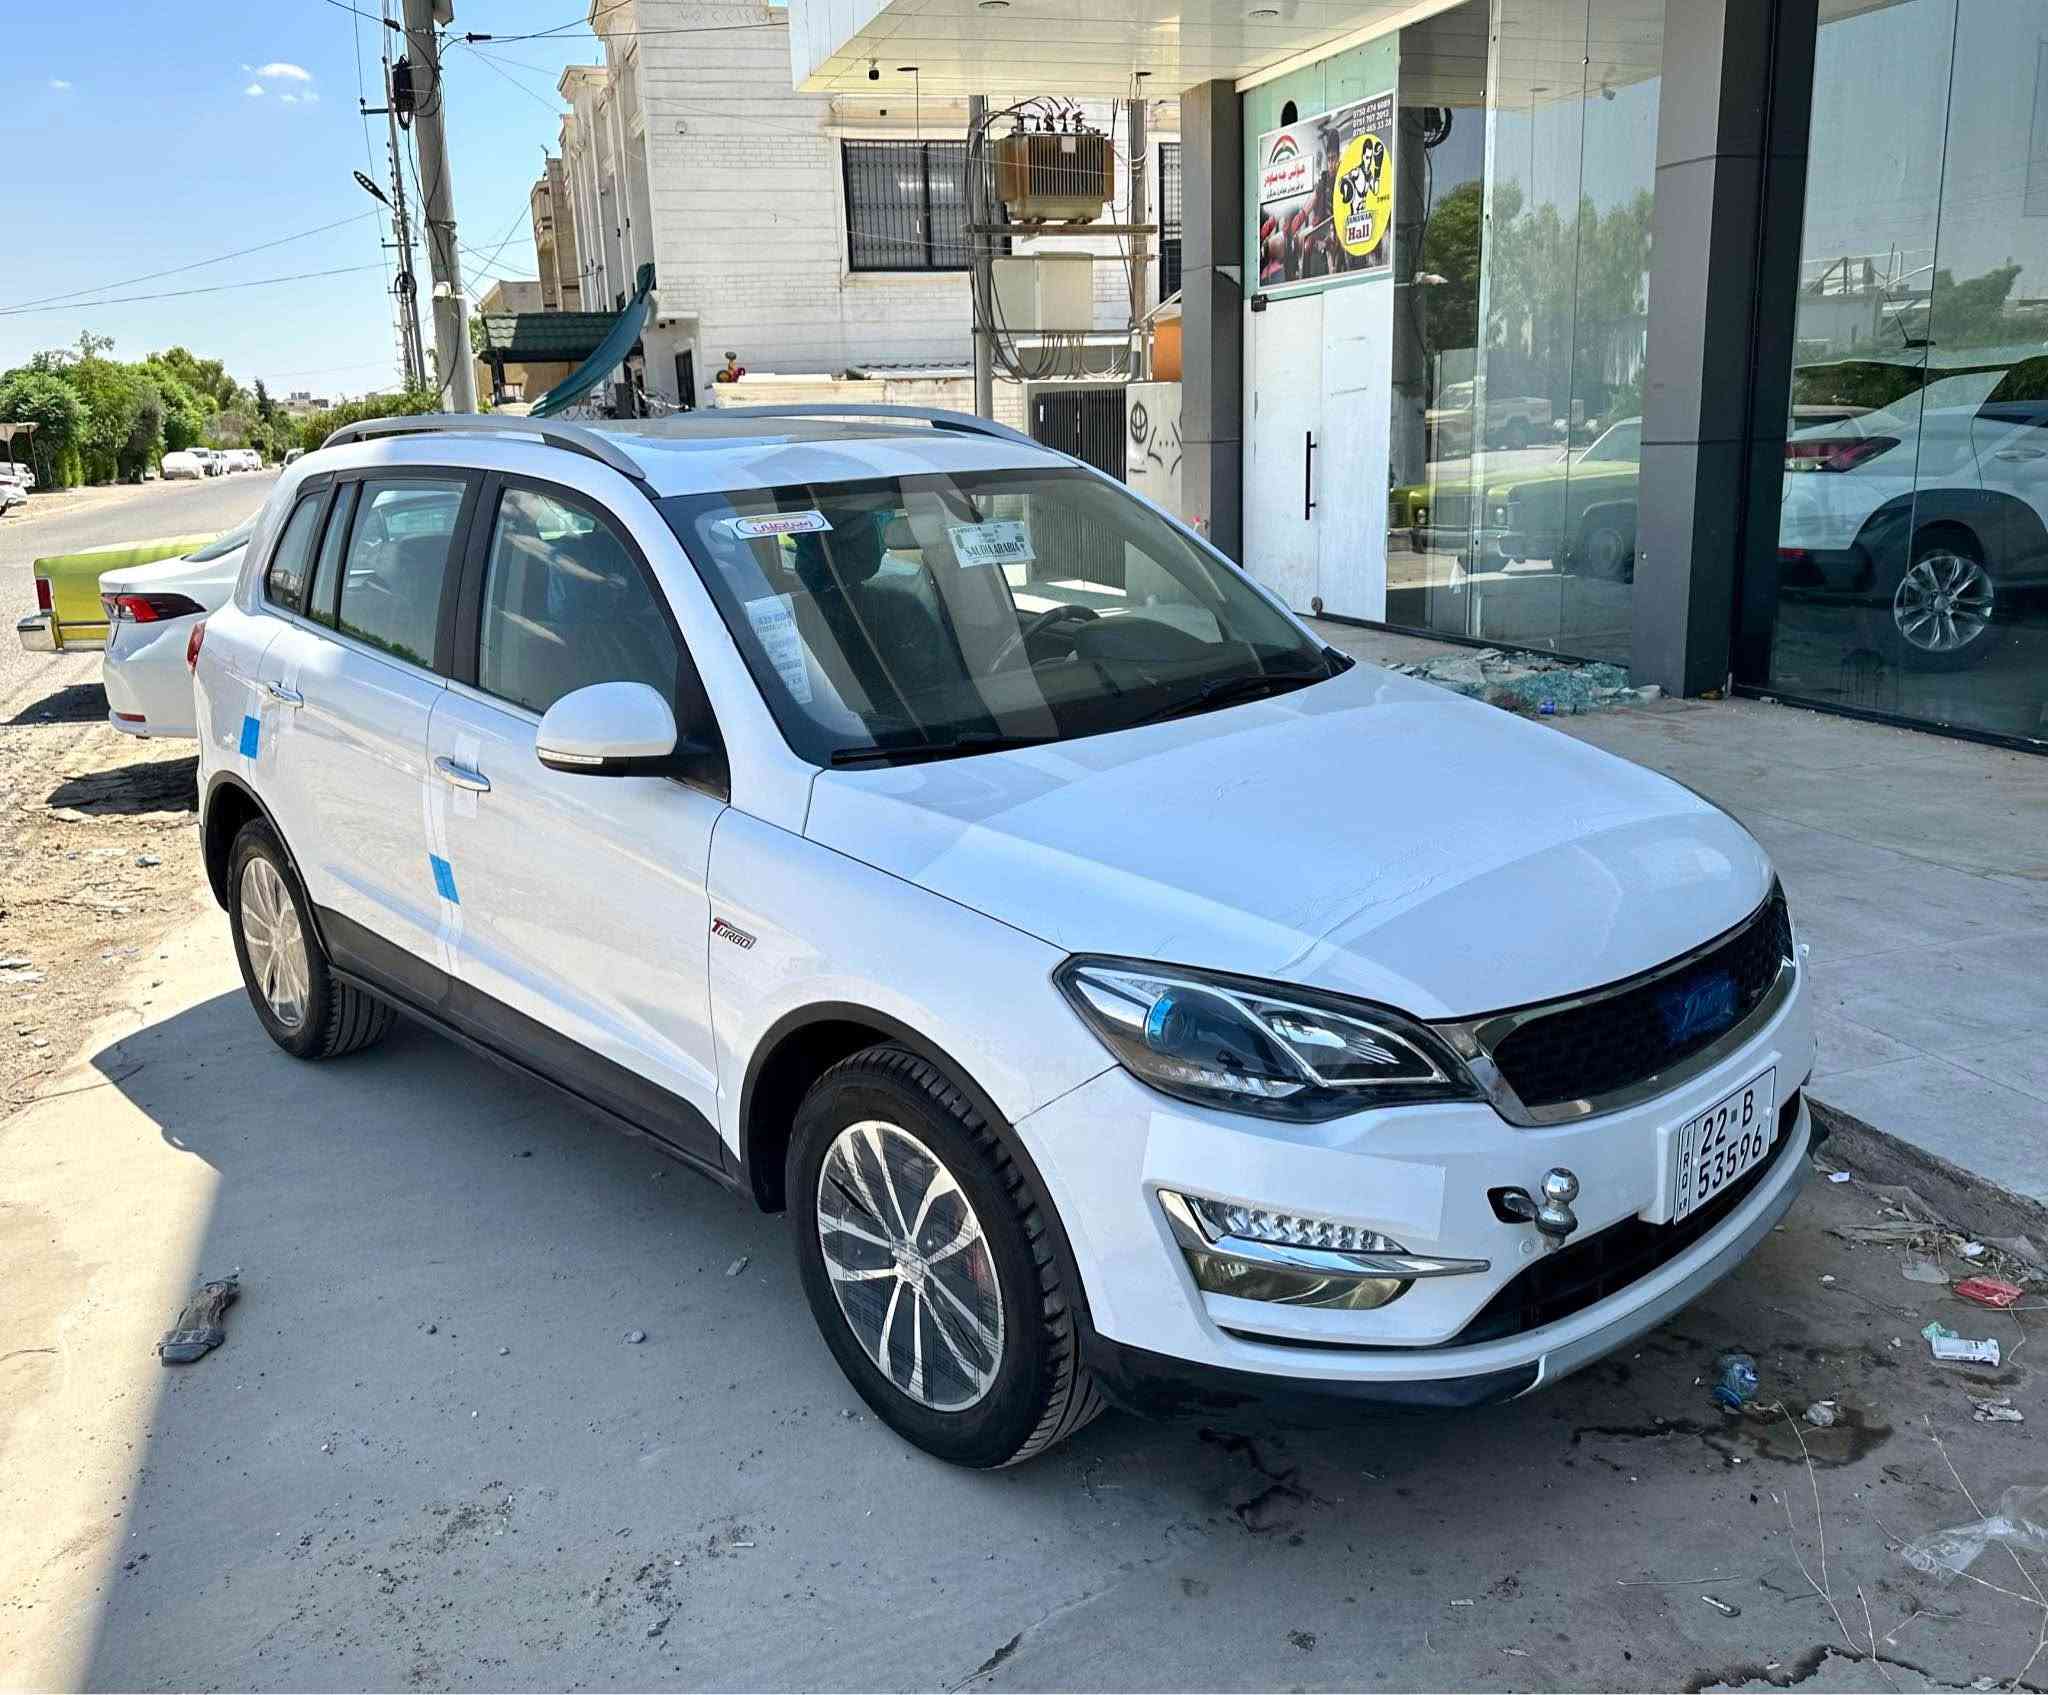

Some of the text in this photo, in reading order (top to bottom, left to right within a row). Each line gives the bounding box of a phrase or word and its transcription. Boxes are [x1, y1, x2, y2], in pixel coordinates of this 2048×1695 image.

[1348, 223, 1370, 241] Hall
[712, 917, 755, 949] TURBO
[1700, 1090, 1754, 1156] 22 B
[1697, 1123, 1762, 1200] 53596
